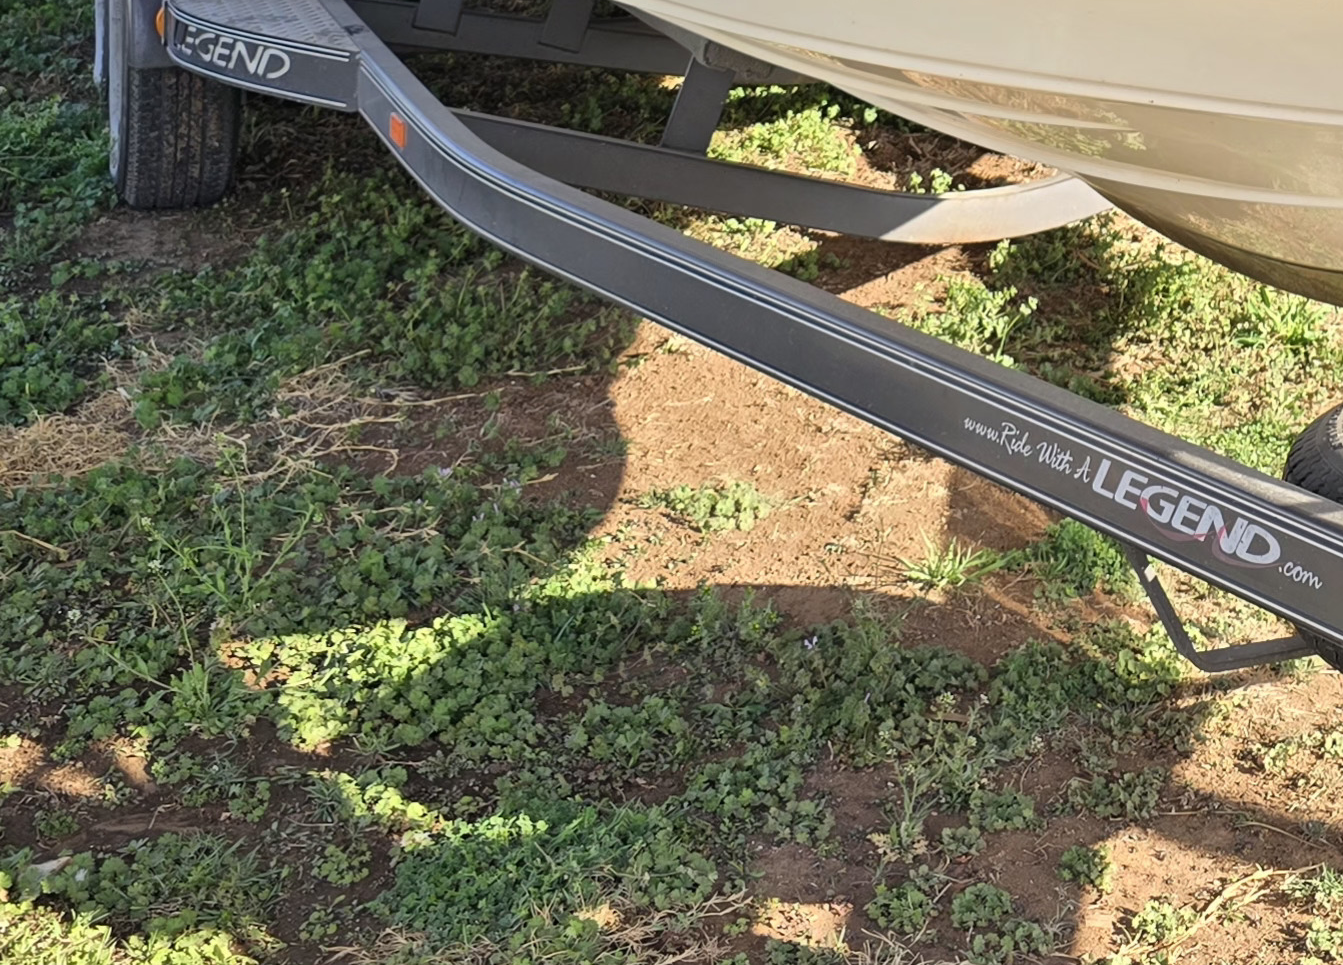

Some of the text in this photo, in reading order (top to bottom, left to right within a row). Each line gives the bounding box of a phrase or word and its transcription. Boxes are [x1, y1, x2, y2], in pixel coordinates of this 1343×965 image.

[1036, 442, 1074, 474] With
[1073, 456, 1092, 483] A
[1092, 458, 1281, 565] LEGEND
